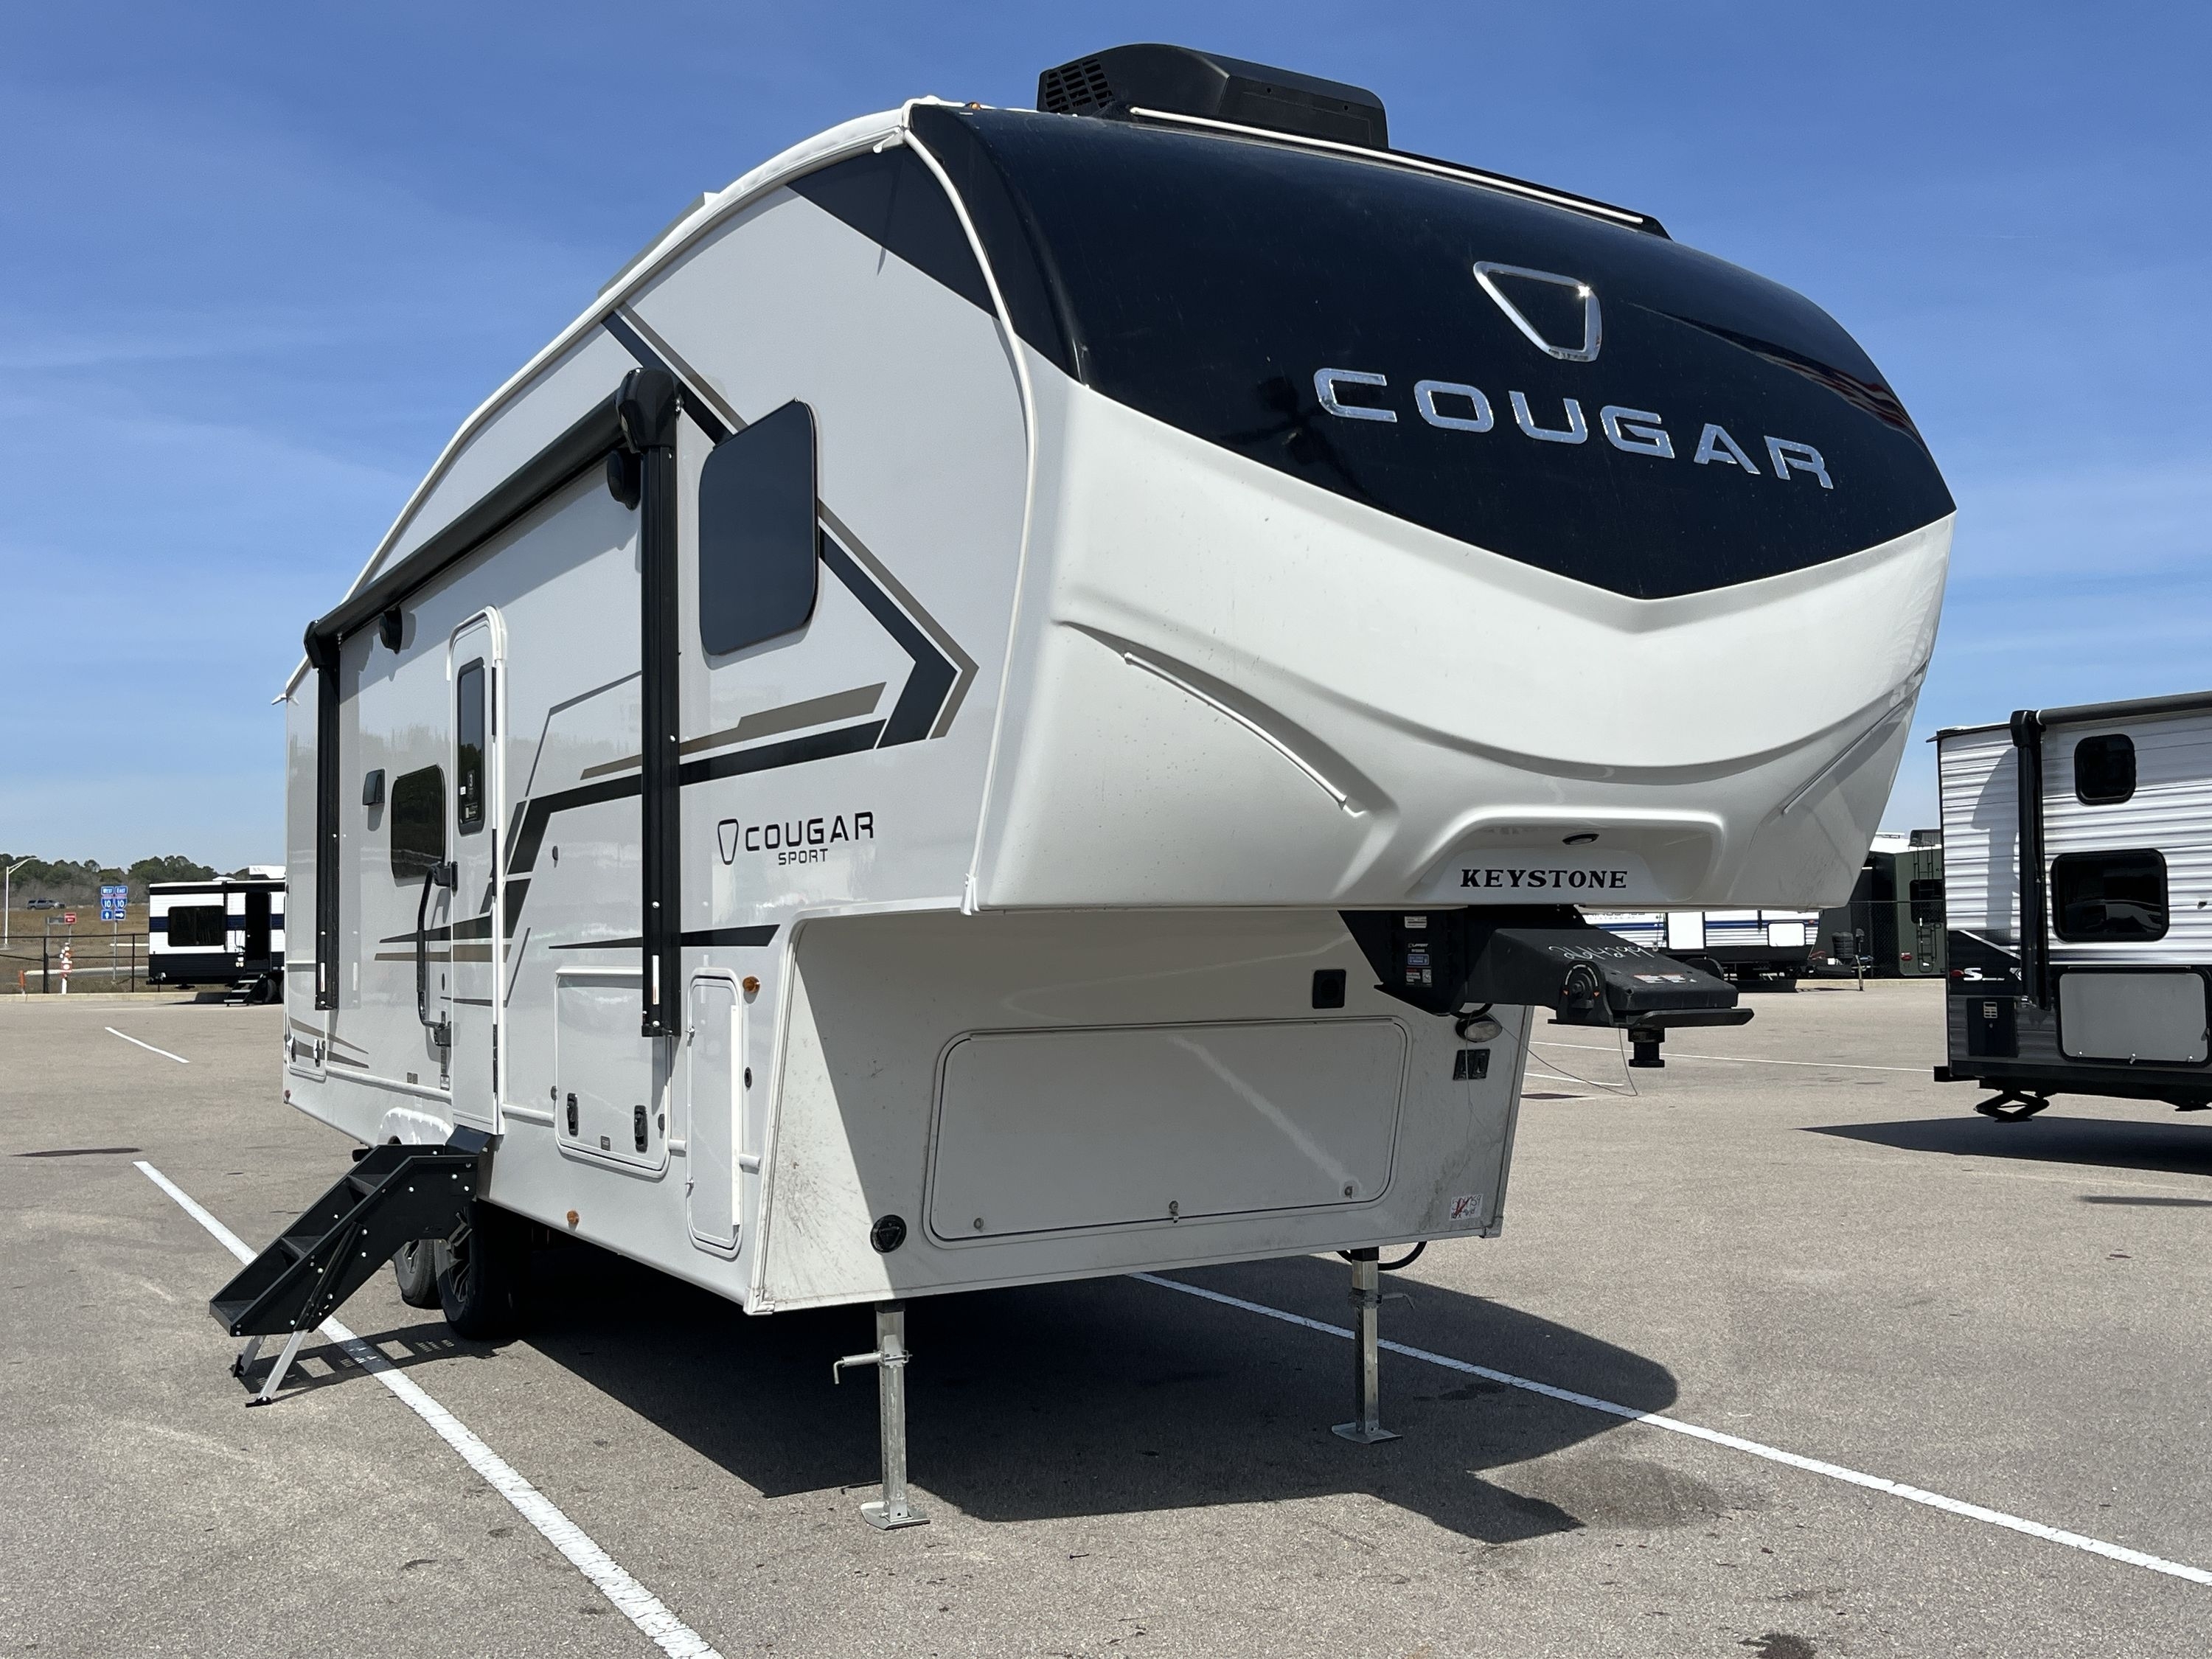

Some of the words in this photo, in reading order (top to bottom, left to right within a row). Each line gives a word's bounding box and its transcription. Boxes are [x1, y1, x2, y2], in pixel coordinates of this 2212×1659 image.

[1313, 367, 1834, 490] COUGAR
[745, 812, 874, 852] COUGAR
[778, 848, 828, 866] SPORT
[1460, 869, 1628, 888] KEYSTONE
[104, 900, 111, 908] 10
[117, 900, 125, 908] 10
